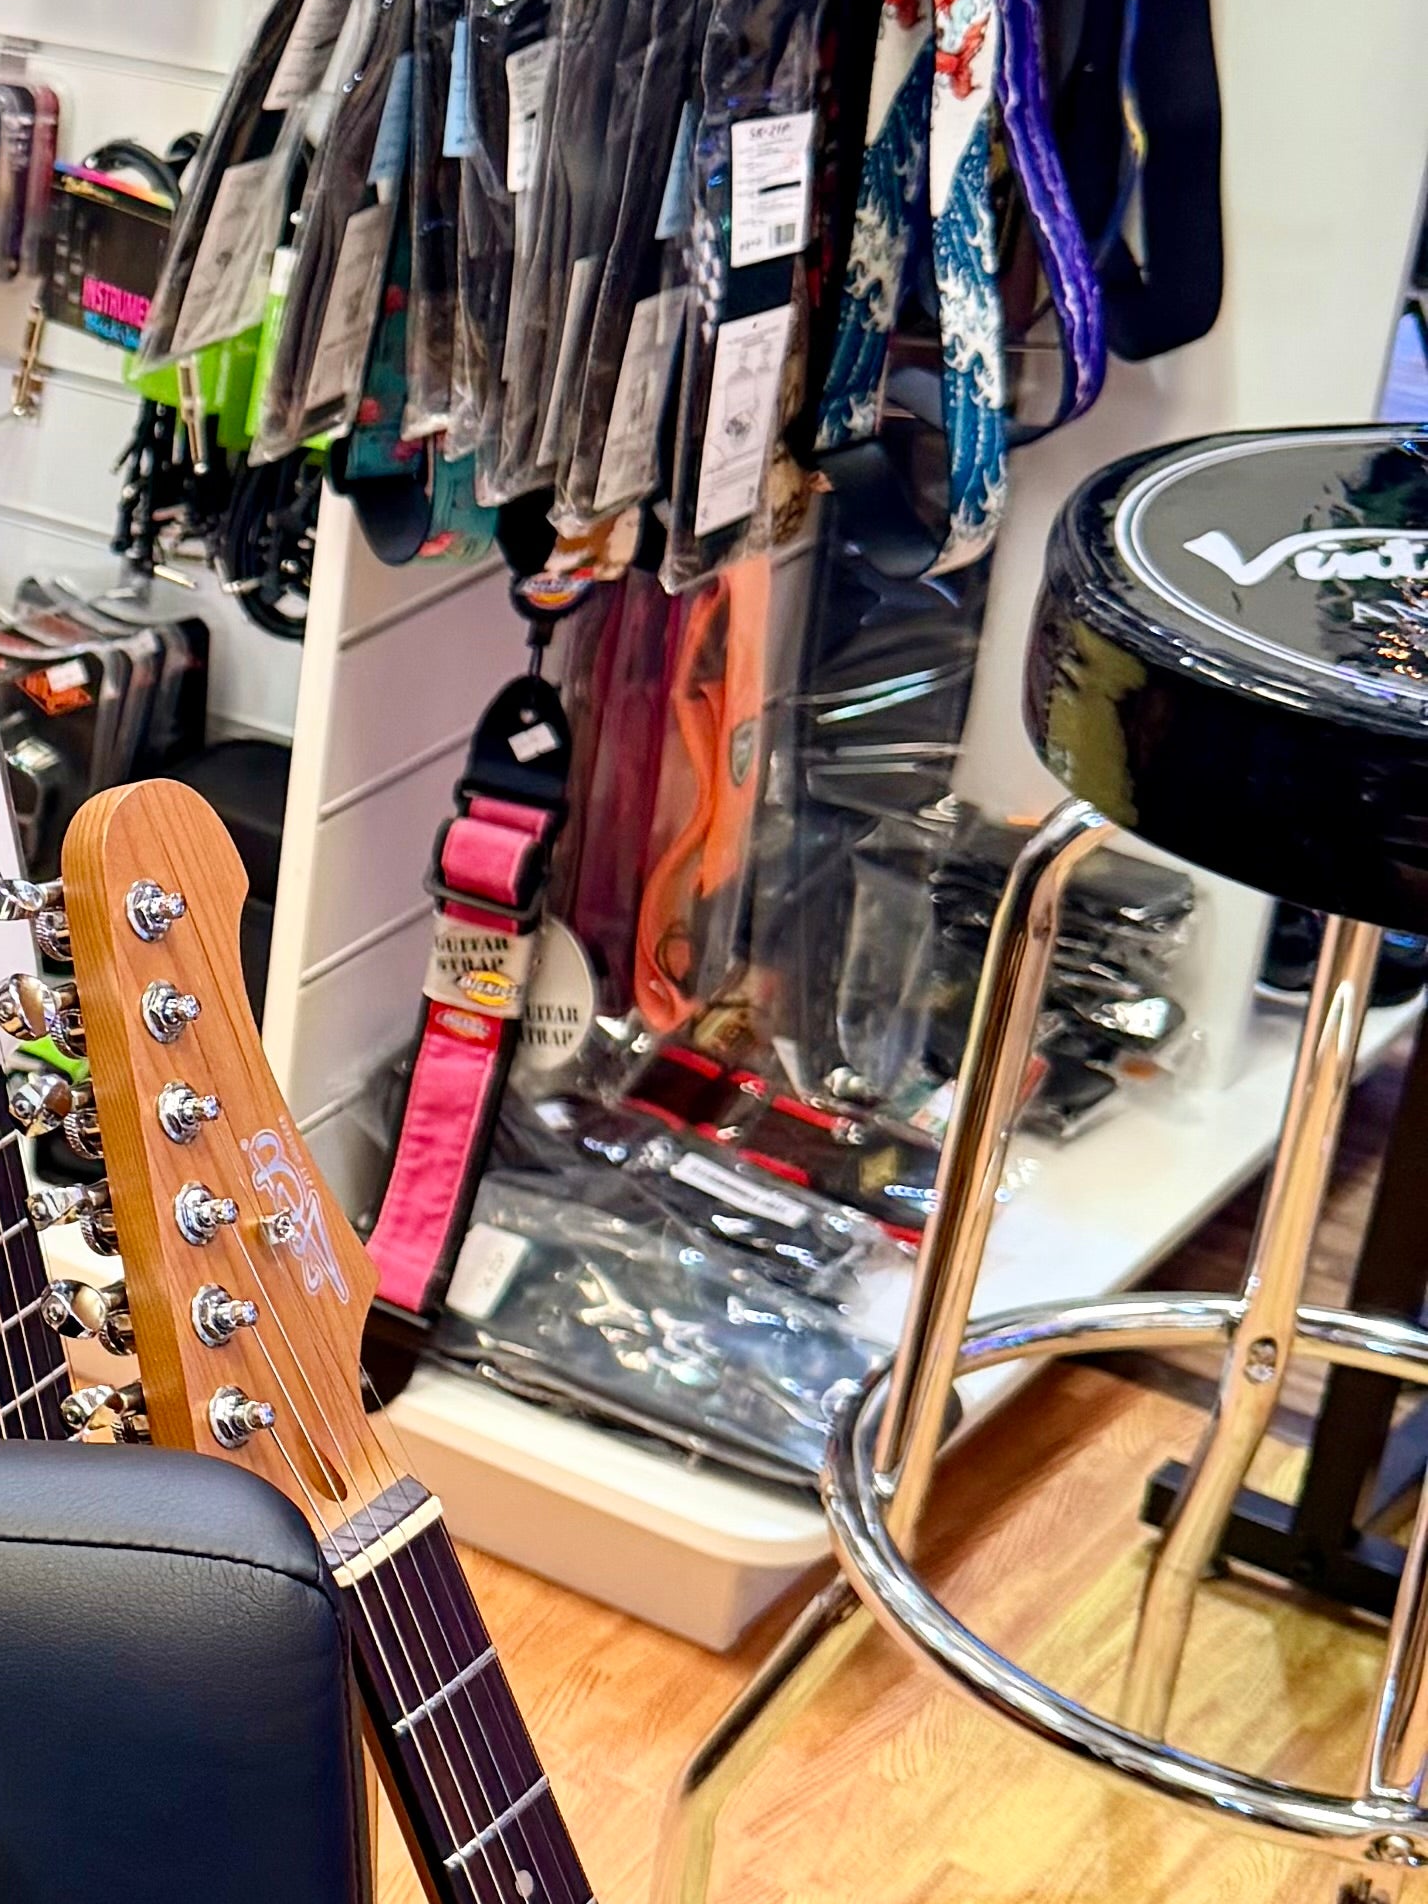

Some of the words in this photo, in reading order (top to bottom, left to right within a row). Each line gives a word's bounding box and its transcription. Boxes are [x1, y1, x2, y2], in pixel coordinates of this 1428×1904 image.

[435, 937, 509, 953] GUITAR
[437, 957, 504, 972] STRAP
[523, 1004, 579, 1024] UITAR
[520, 1027, 574, 1046] TRAP
